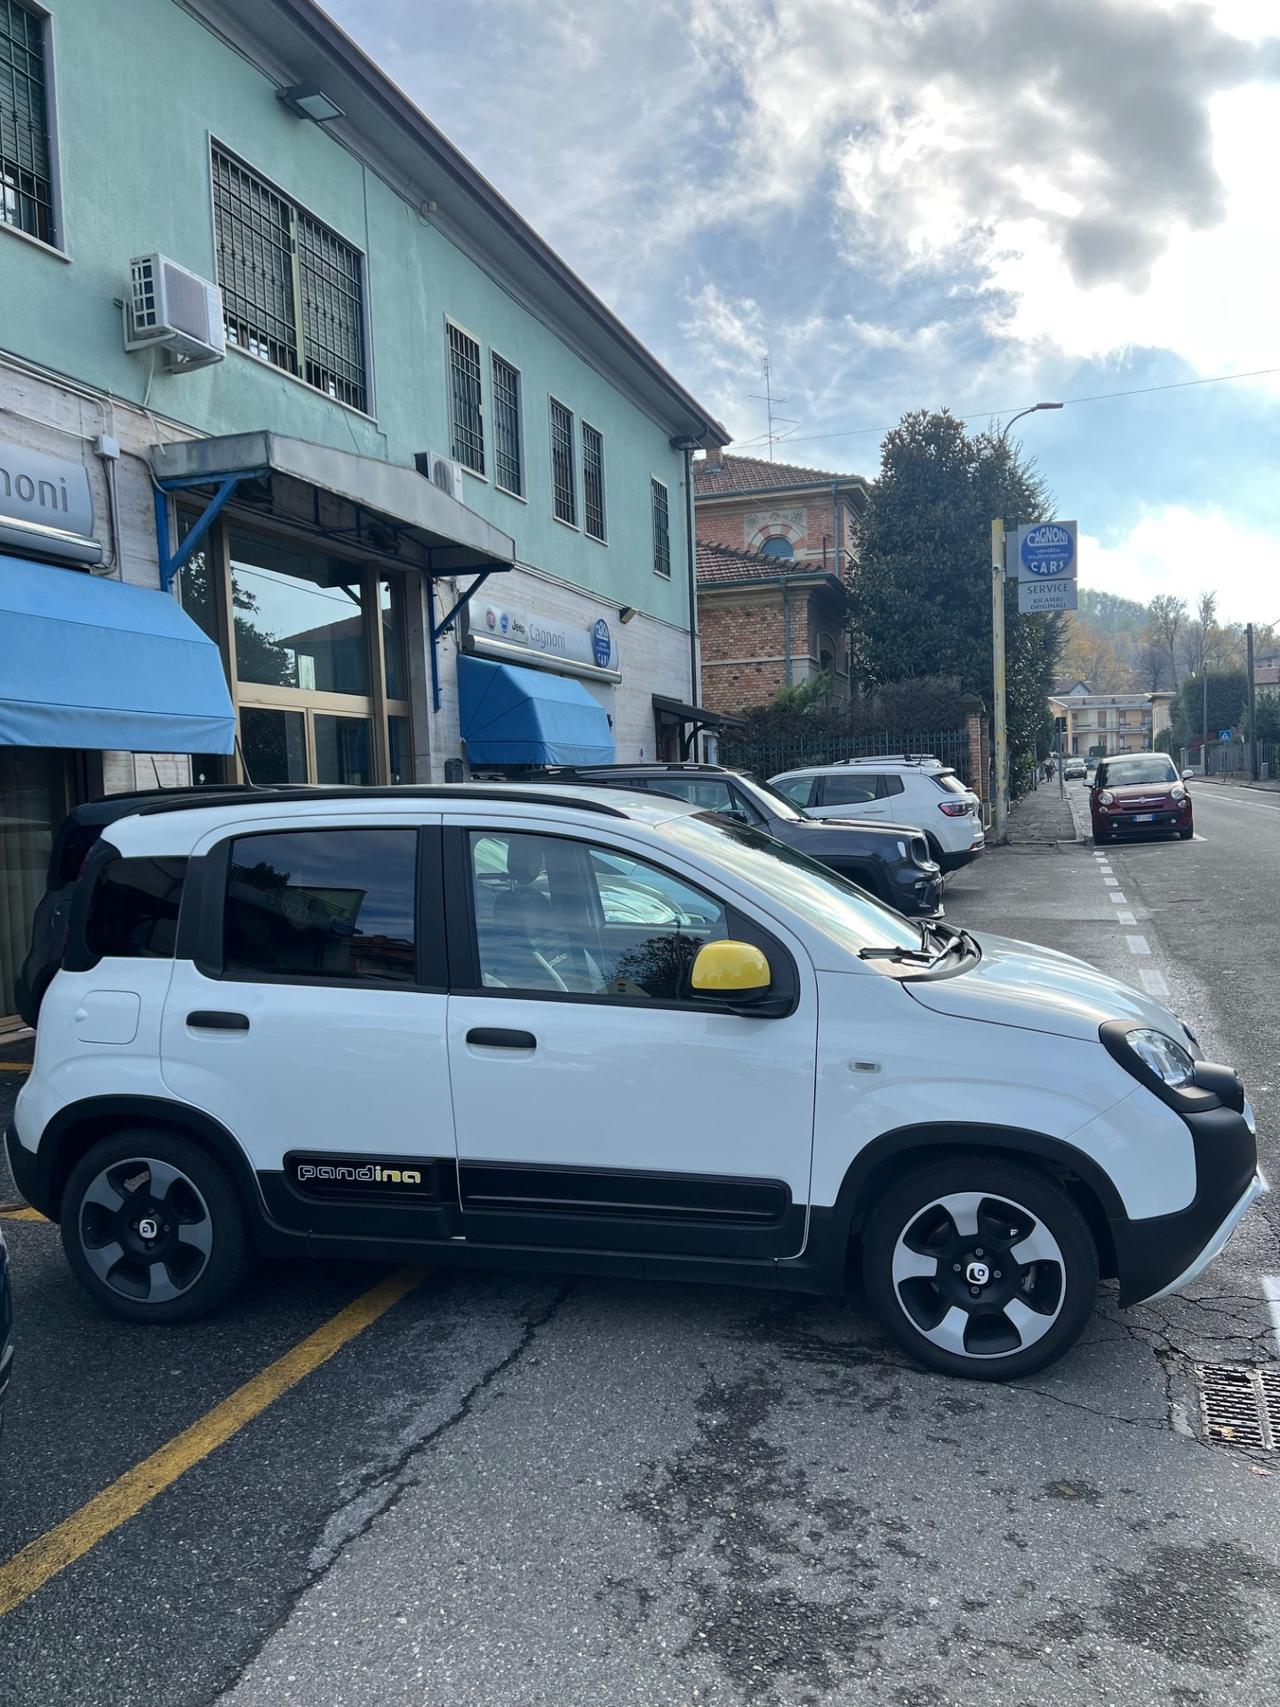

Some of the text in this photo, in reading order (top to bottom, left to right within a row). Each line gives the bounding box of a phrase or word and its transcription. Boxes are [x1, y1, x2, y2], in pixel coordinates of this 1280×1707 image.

[1026, 526, 1068, 547] CAGNONI
[1027, 583, 1069, 595] SERVICE
[529, 623, 567, 650] Cagnoni
[298, 1165, 421, 1184] pandina
